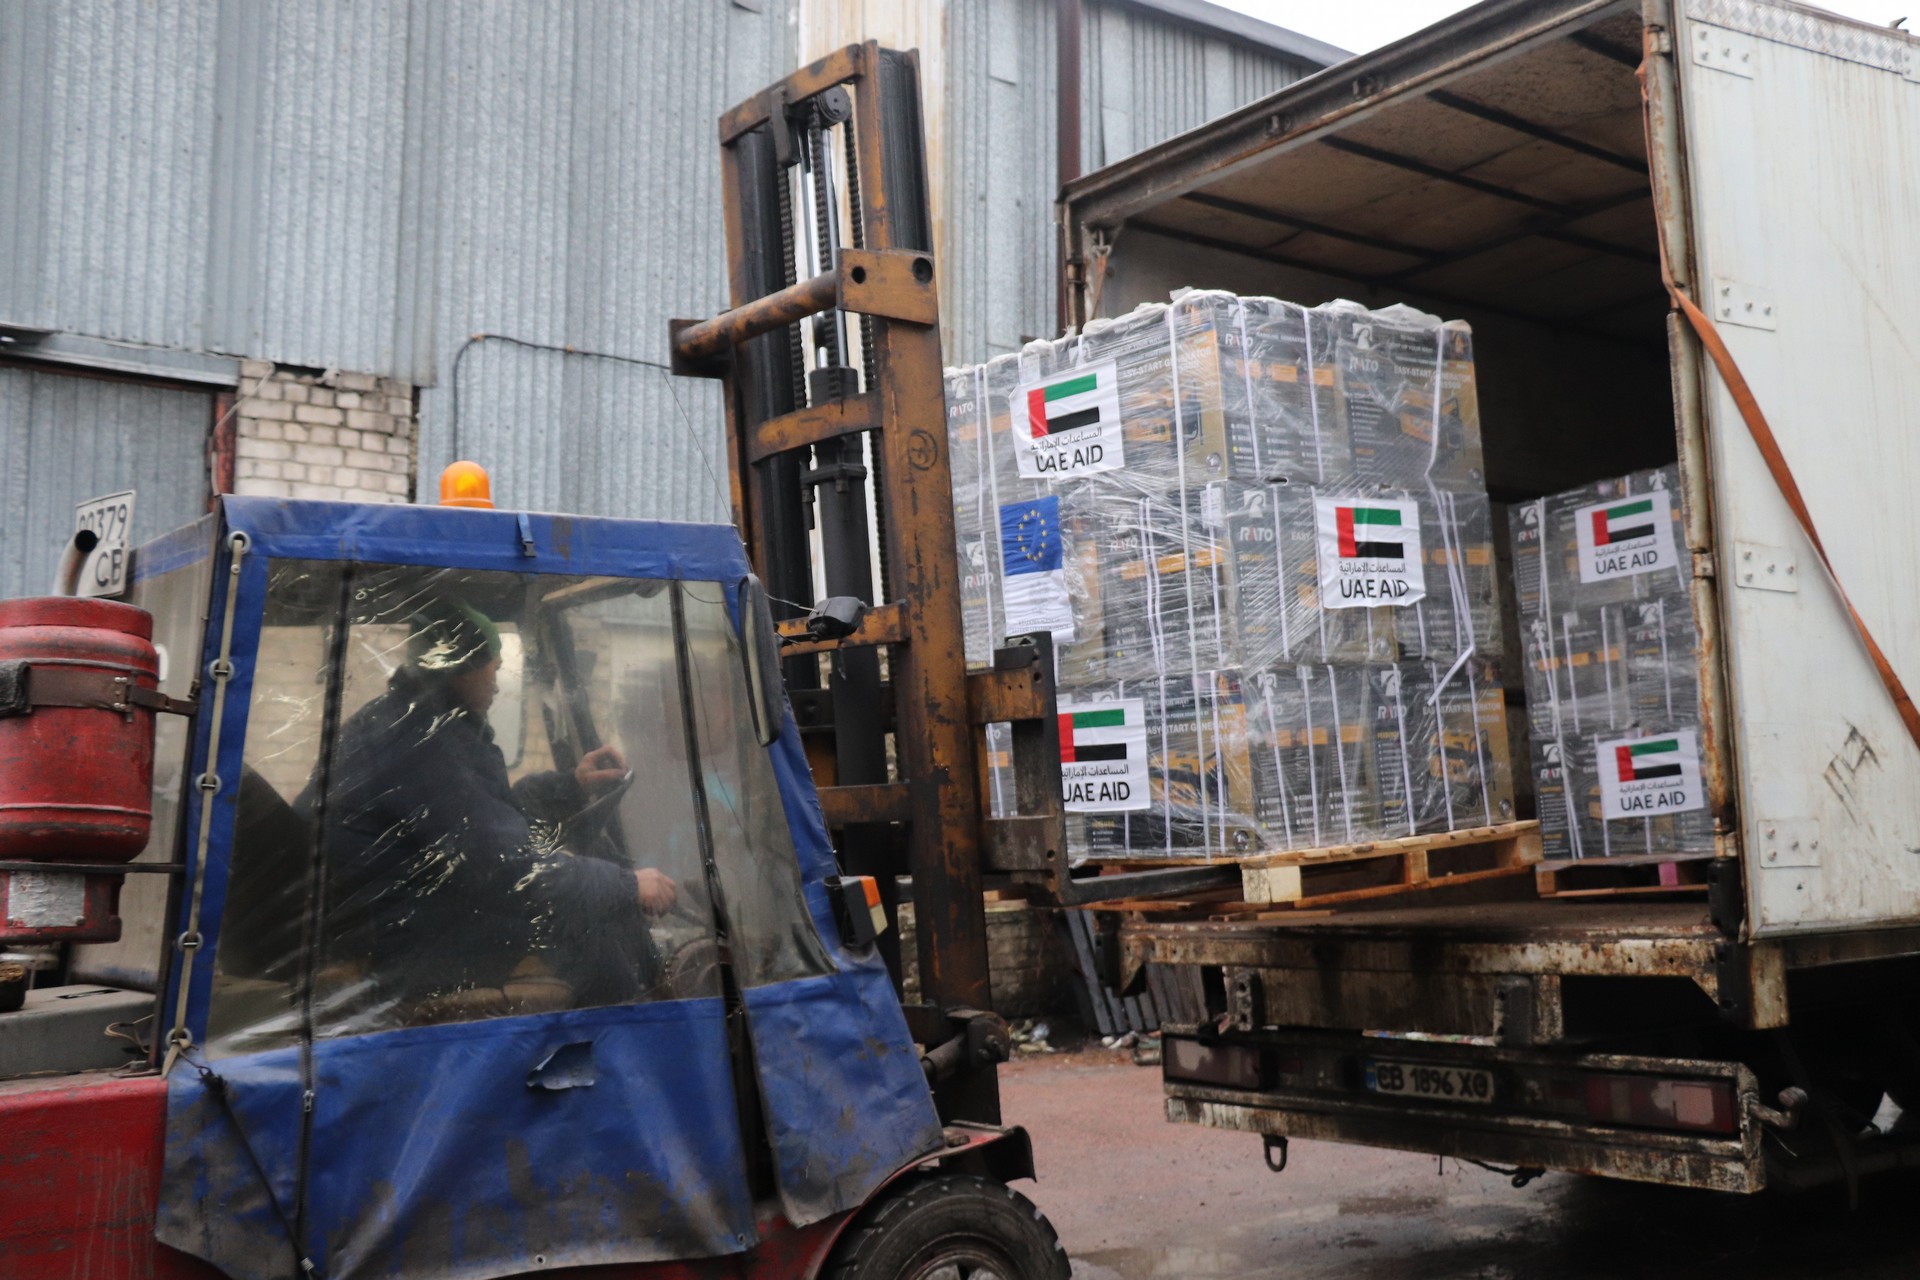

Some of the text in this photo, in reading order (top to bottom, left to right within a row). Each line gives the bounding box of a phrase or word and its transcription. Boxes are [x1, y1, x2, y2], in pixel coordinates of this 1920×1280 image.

[1225, 333, 1253, 347] RAO
[950, 401, 974, 418] RATO
[1035, 444, 1104, 473] UAE AID
[1239, 526, 1273, 542] RATO
[1518, 528, 1541, 542] RAT
[1368, 562, 1406, 573] المساعدات
[1595, 550, 1659, 575] UAE AID
[1340, 578, 1410, 598] UAE AID
[1422, 703, 1461, 716] EASSTART
[1146, 722, 1189, 736] ASYSTART
[1061, 764, 1129, 781] المساعدات الإماراتي
[1540, 767, 1565, 780] RAT
[1063, 781, 1131, 803] UAE AID
[1620, 791, 1686, 811] UAE AID
[1409, 1067, 1455, 1096] 1896
